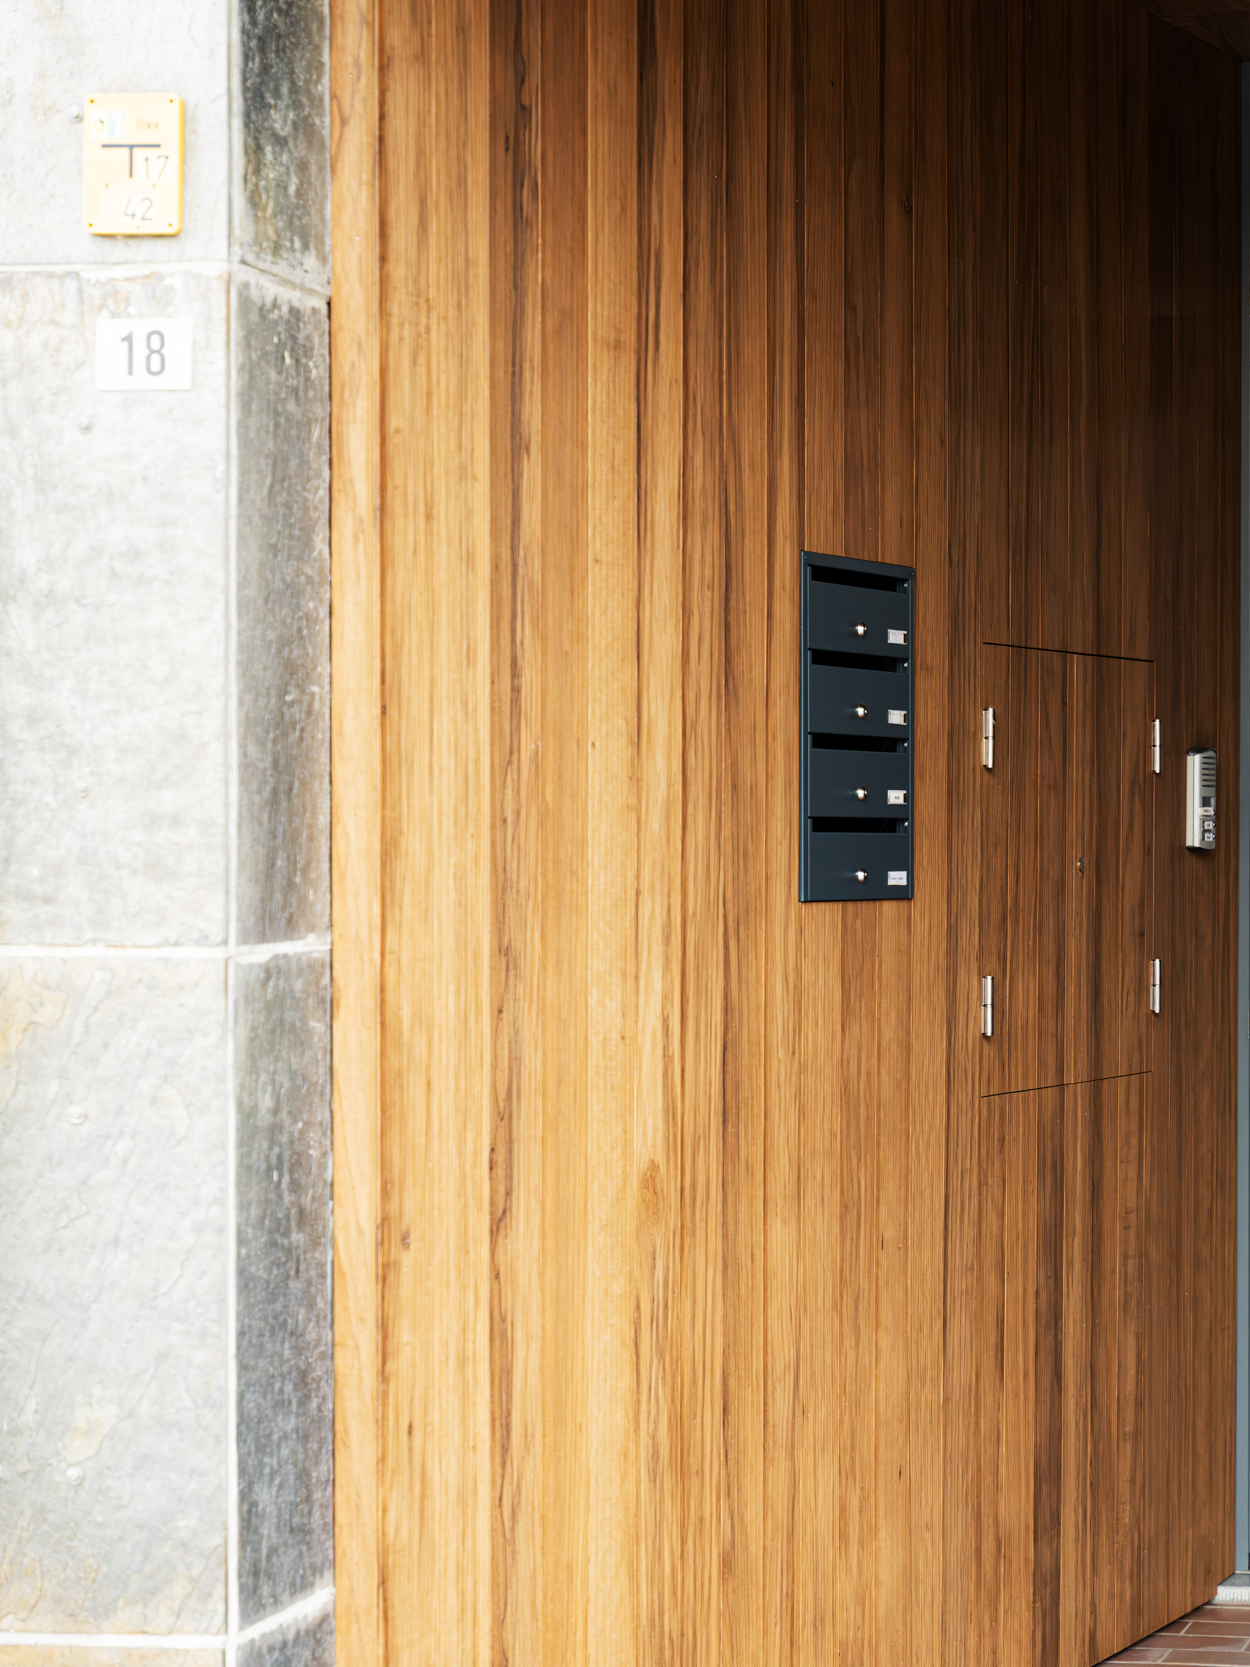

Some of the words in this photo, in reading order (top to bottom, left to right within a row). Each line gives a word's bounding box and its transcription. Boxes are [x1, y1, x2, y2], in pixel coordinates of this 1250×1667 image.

[136, 118, 160, 130] Gas
[143, 155, 170, 180] 17
[123, 196, 154, 221] 42
[120, 329, 166, 376] 18
